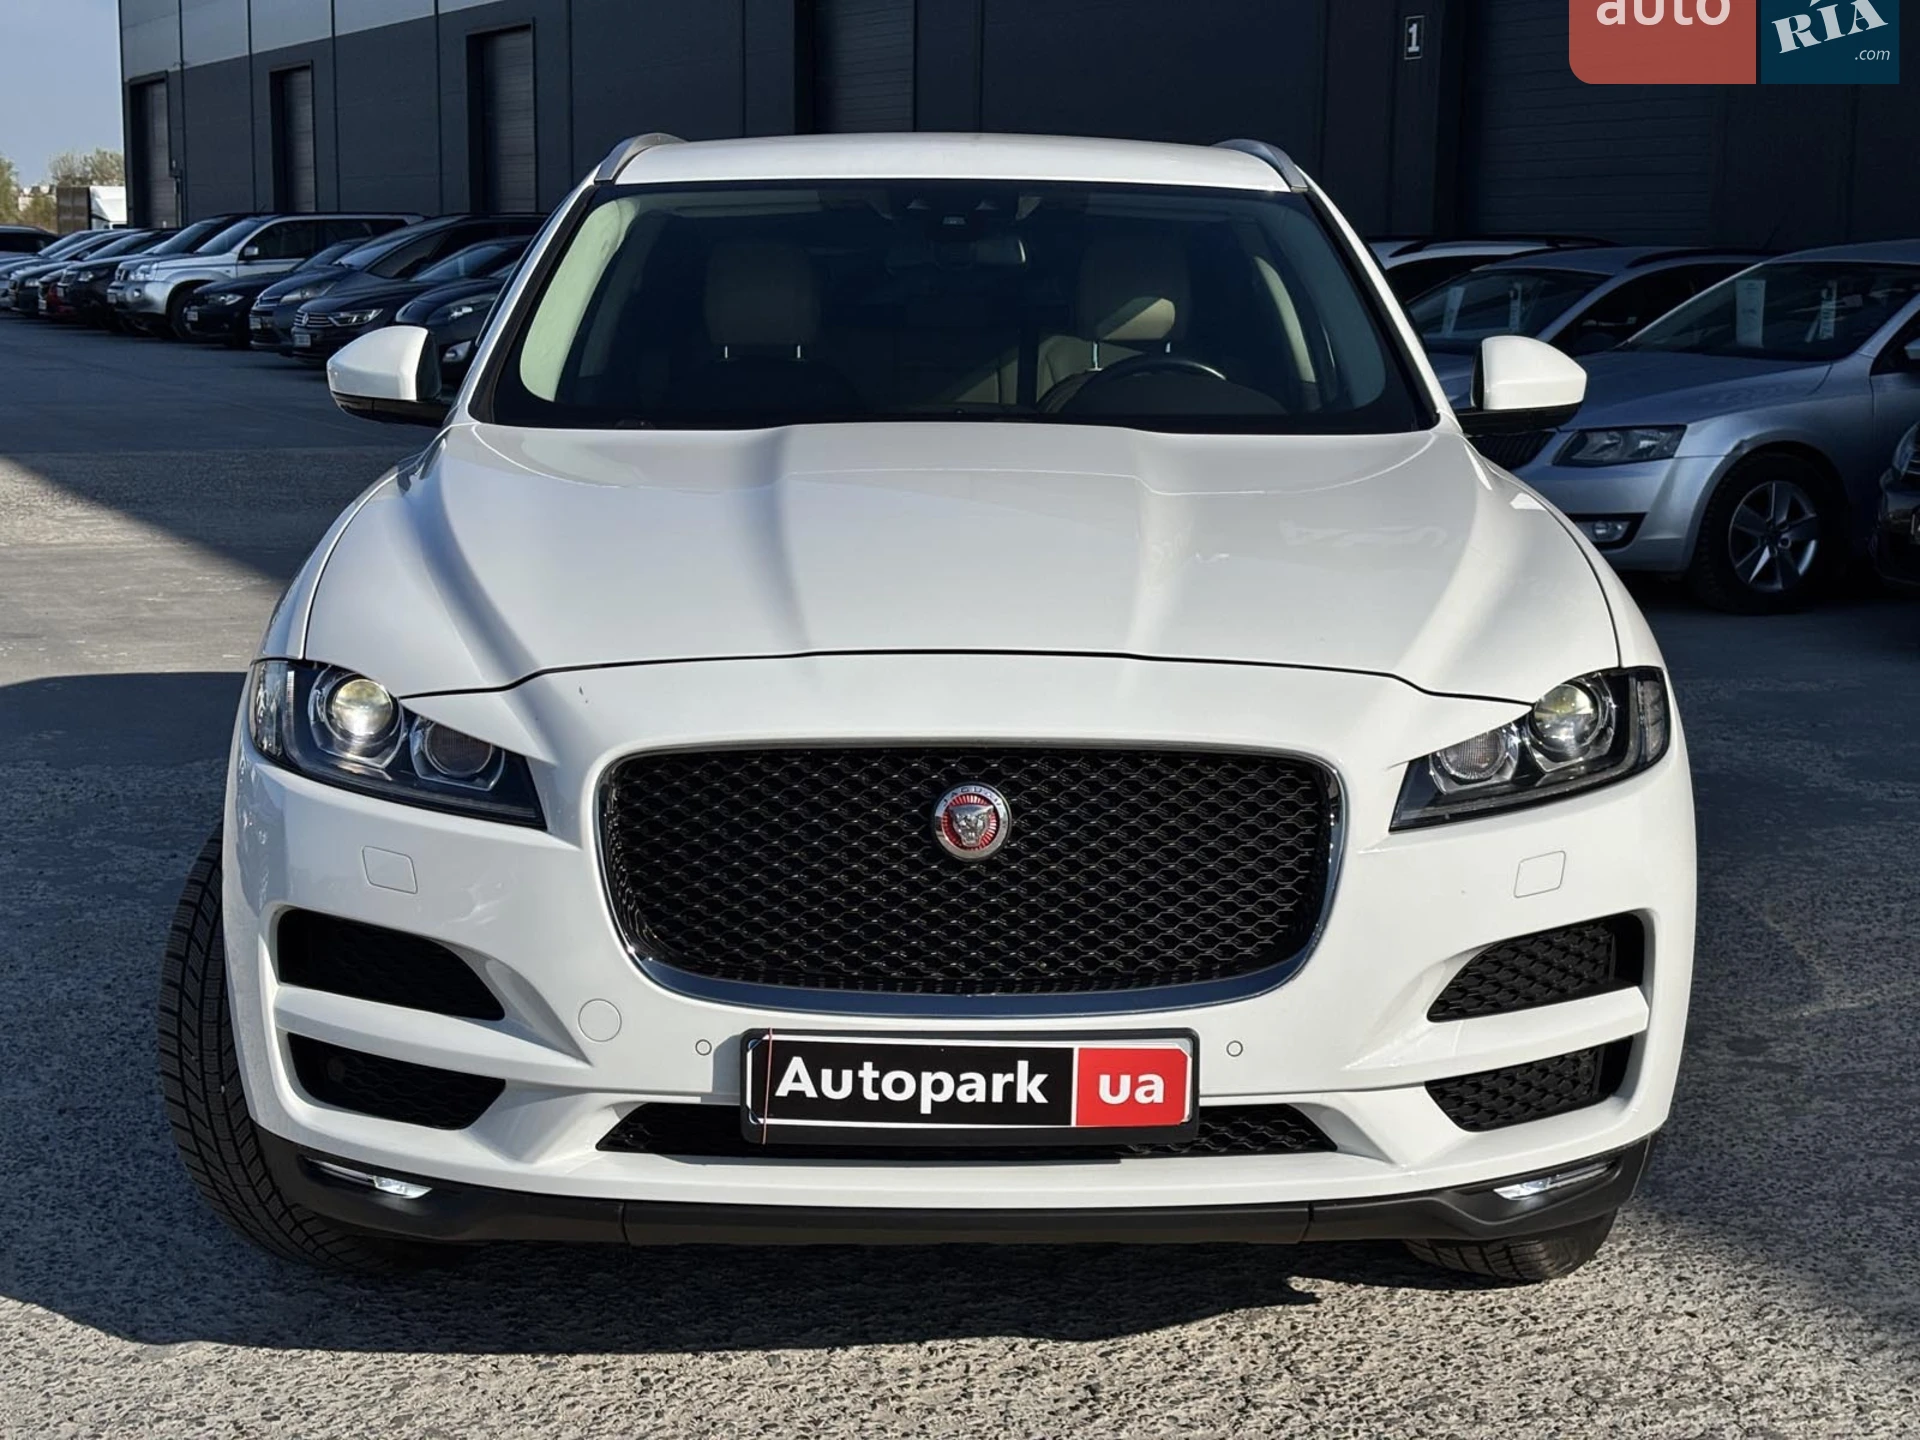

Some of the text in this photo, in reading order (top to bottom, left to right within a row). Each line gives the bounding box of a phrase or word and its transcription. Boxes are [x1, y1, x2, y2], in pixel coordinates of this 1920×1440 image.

[1408, 23, 1420, 53] 1
[774, 1055, 1166, 1115] Autopark ua
